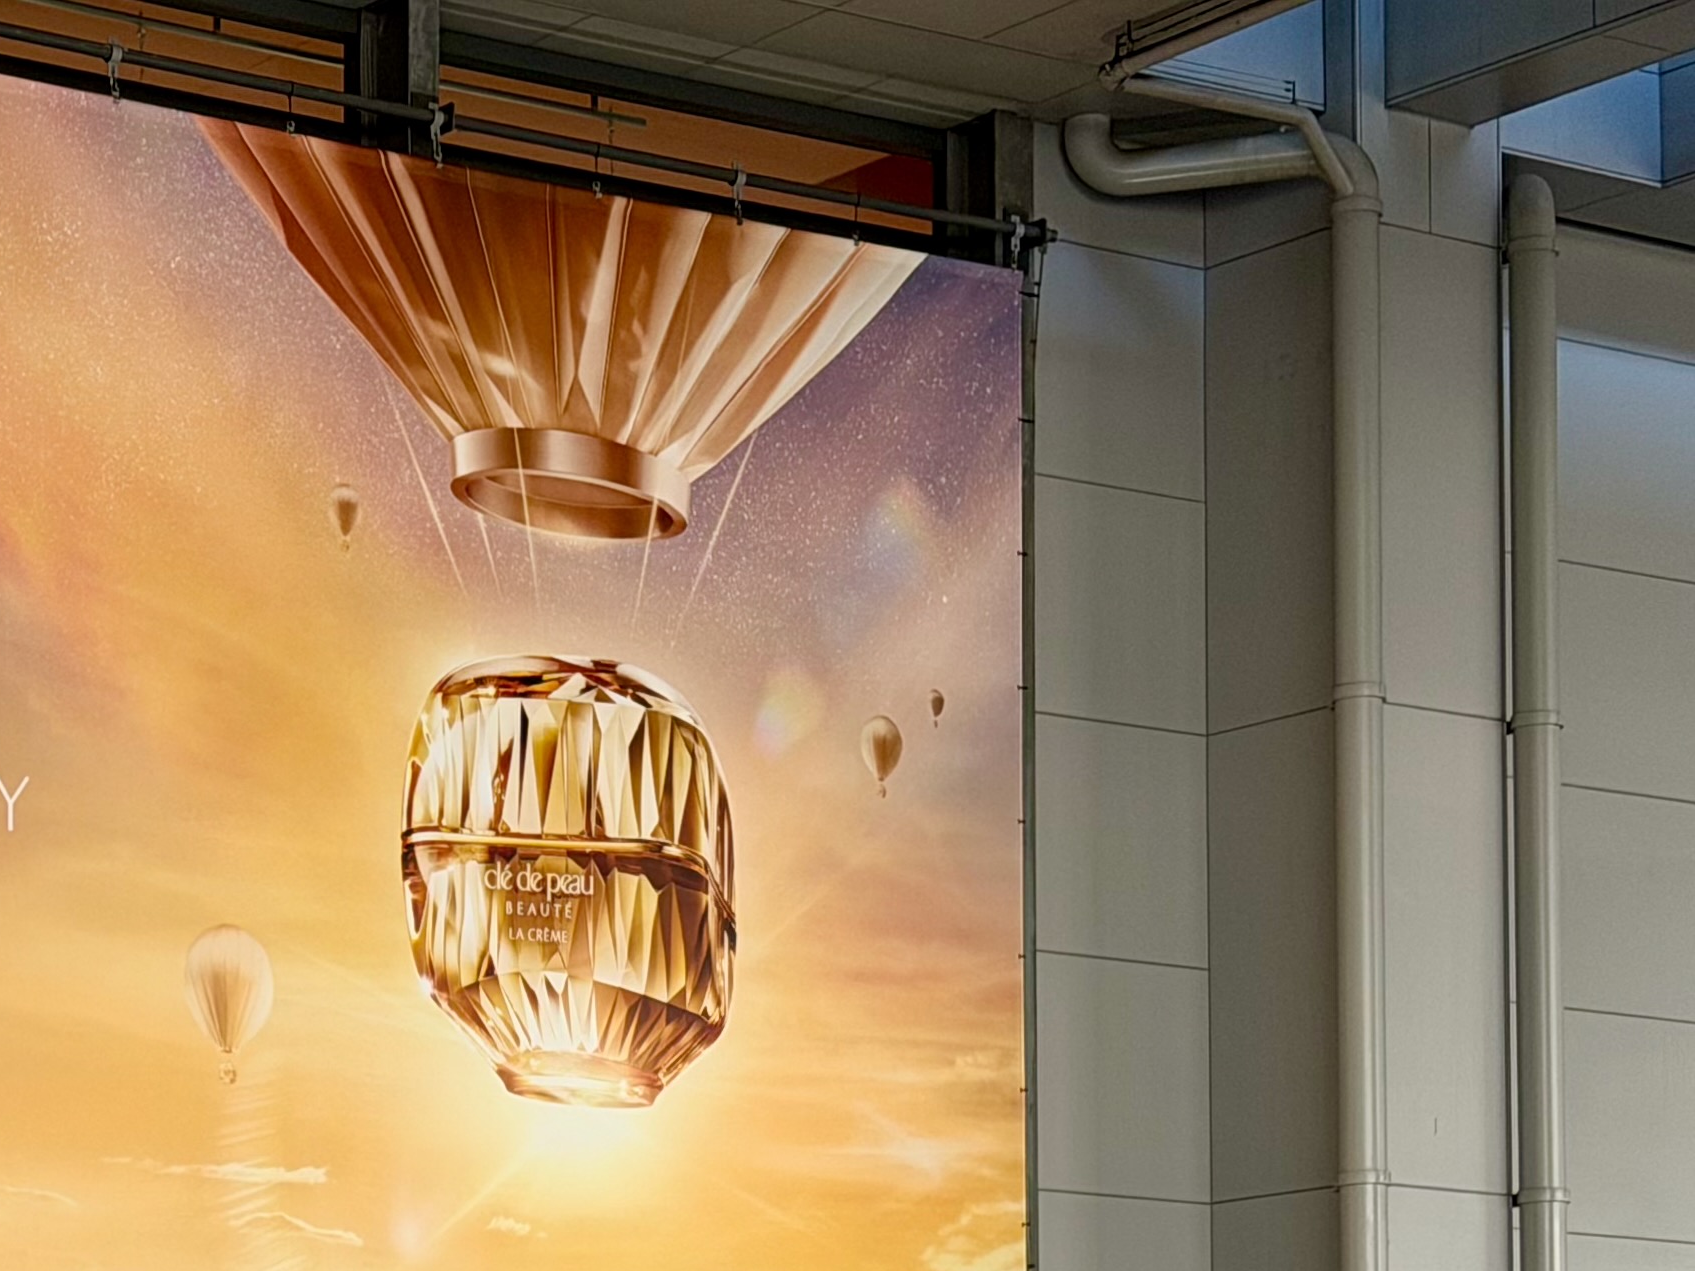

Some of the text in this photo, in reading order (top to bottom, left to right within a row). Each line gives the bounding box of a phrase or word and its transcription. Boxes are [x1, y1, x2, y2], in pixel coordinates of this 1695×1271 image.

[484, 861, 594, 902] clé de peau
[505, 900, 572, 919] BEAUTÉ
[509, 927, 524, 941] LA
